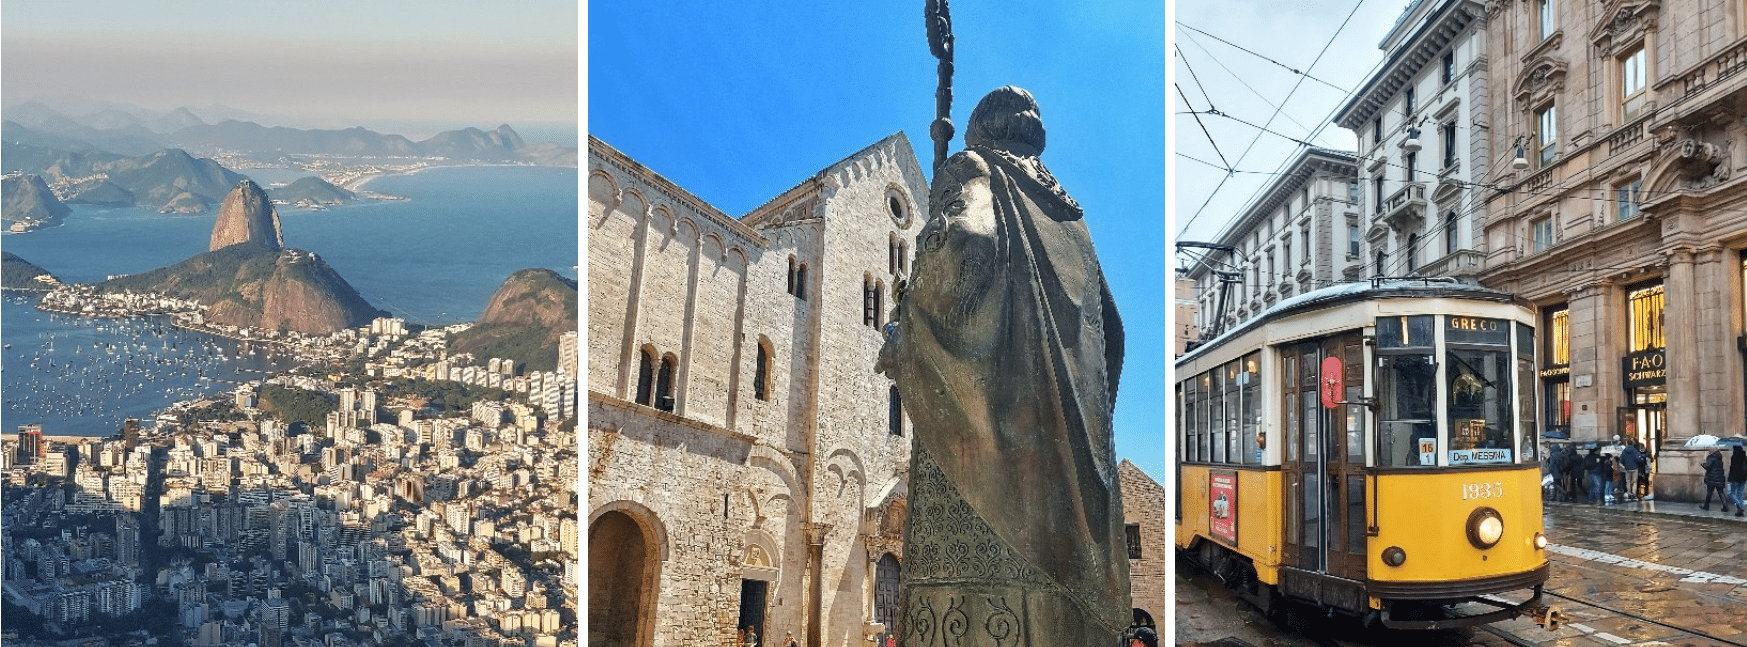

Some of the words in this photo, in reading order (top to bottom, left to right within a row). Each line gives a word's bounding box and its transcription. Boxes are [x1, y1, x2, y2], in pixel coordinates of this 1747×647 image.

[1451, 317, 1497, 331] GRECO
[1628, 369, 1666, 381] SCHWARZ
[1422, 443, 1434, 453] 16
[1425, 454, 1430, 463] 1
[1471, 451, 1506, 461] MESSINA
[1462, 481, 1503, 501] 1935
